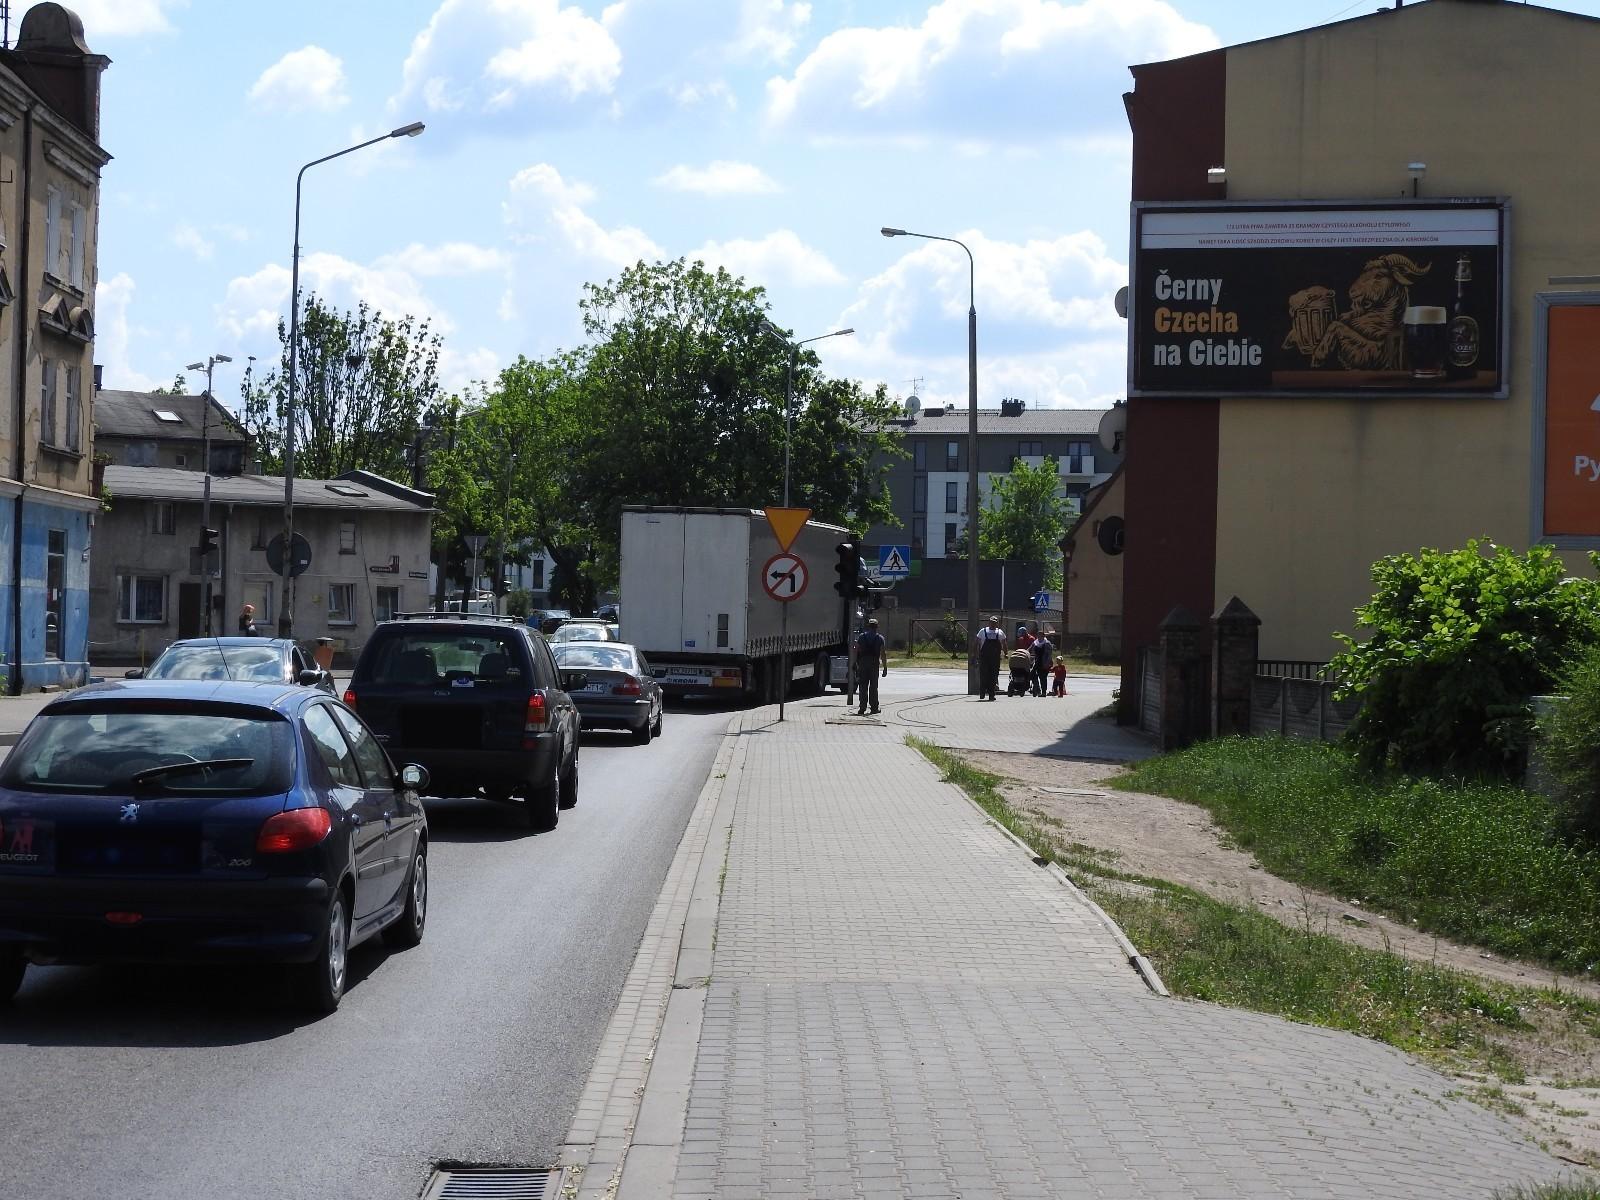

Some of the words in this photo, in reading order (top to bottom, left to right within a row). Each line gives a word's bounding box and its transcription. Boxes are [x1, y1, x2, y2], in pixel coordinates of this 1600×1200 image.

[1155, 269, 1223, 305] Černy
[1154, 306, 1239, 333] Czecha
[1154, 344, 1181, 366] na
[1189, 338, 1262, 366] Ciebie
[0, 853, 39, 862] EUGEOT
